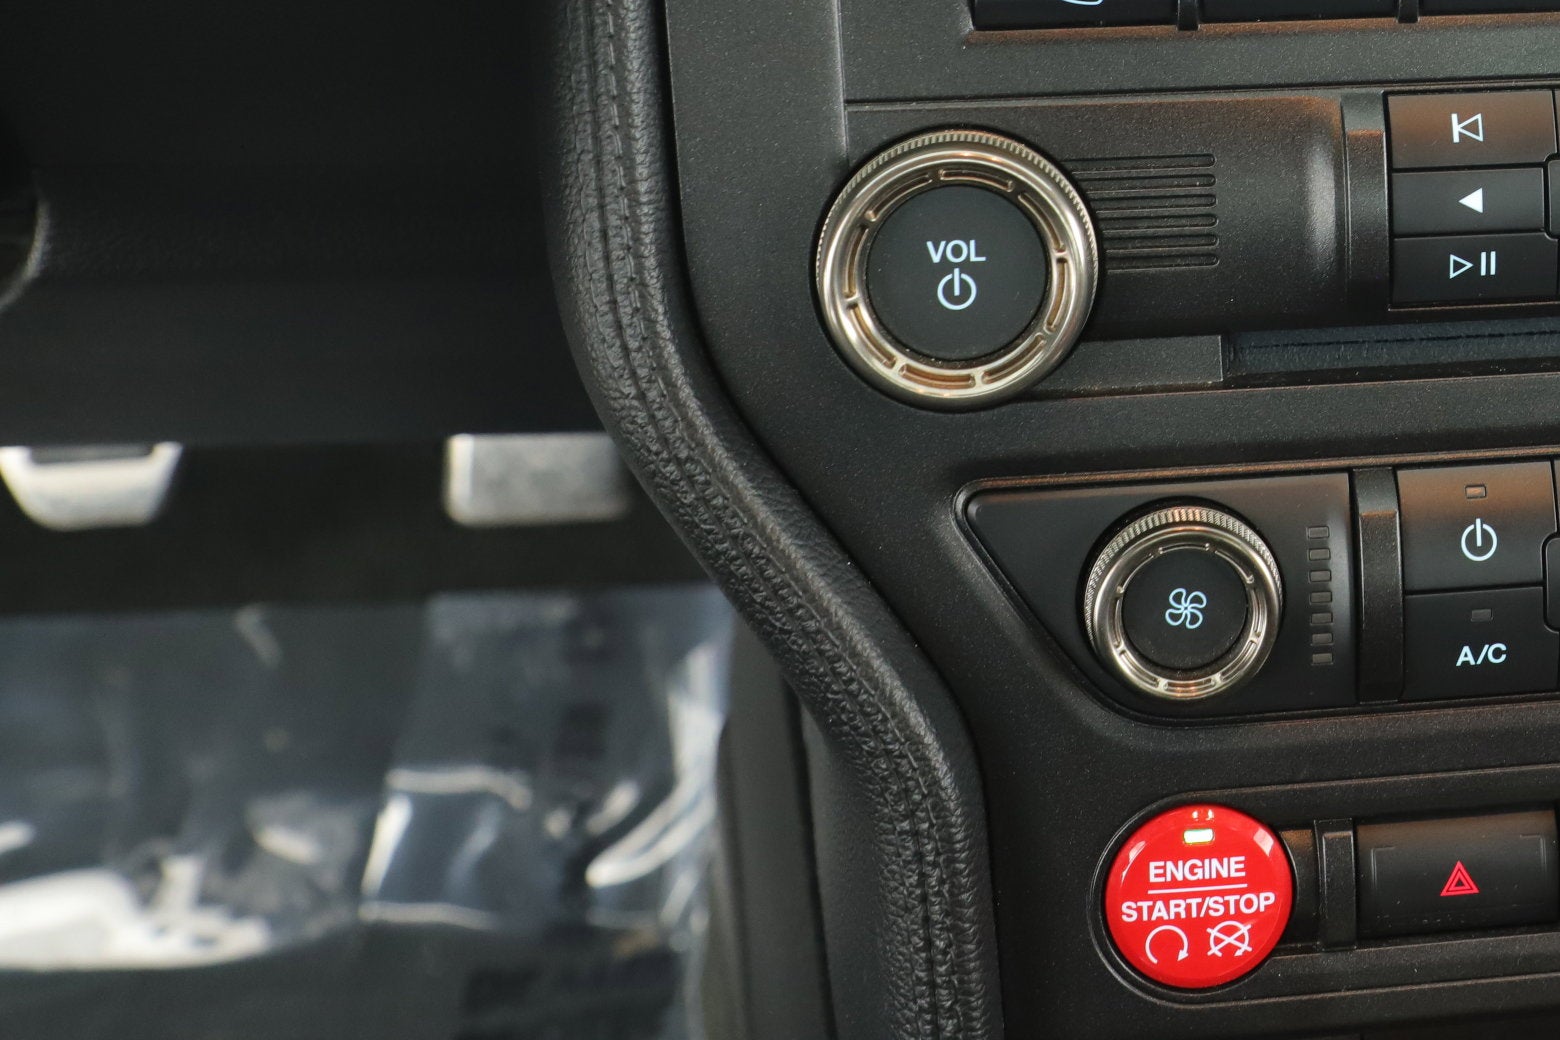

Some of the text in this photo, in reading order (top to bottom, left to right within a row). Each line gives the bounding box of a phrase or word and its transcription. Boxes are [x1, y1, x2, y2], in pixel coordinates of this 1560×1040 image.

[925, 238, 987, 265] VOL
[1454, 641, 1508, 668] A/C
[1148, 855, 1247, 883] ENGINE
[1120, 891, 1277, 923] START/STOP
